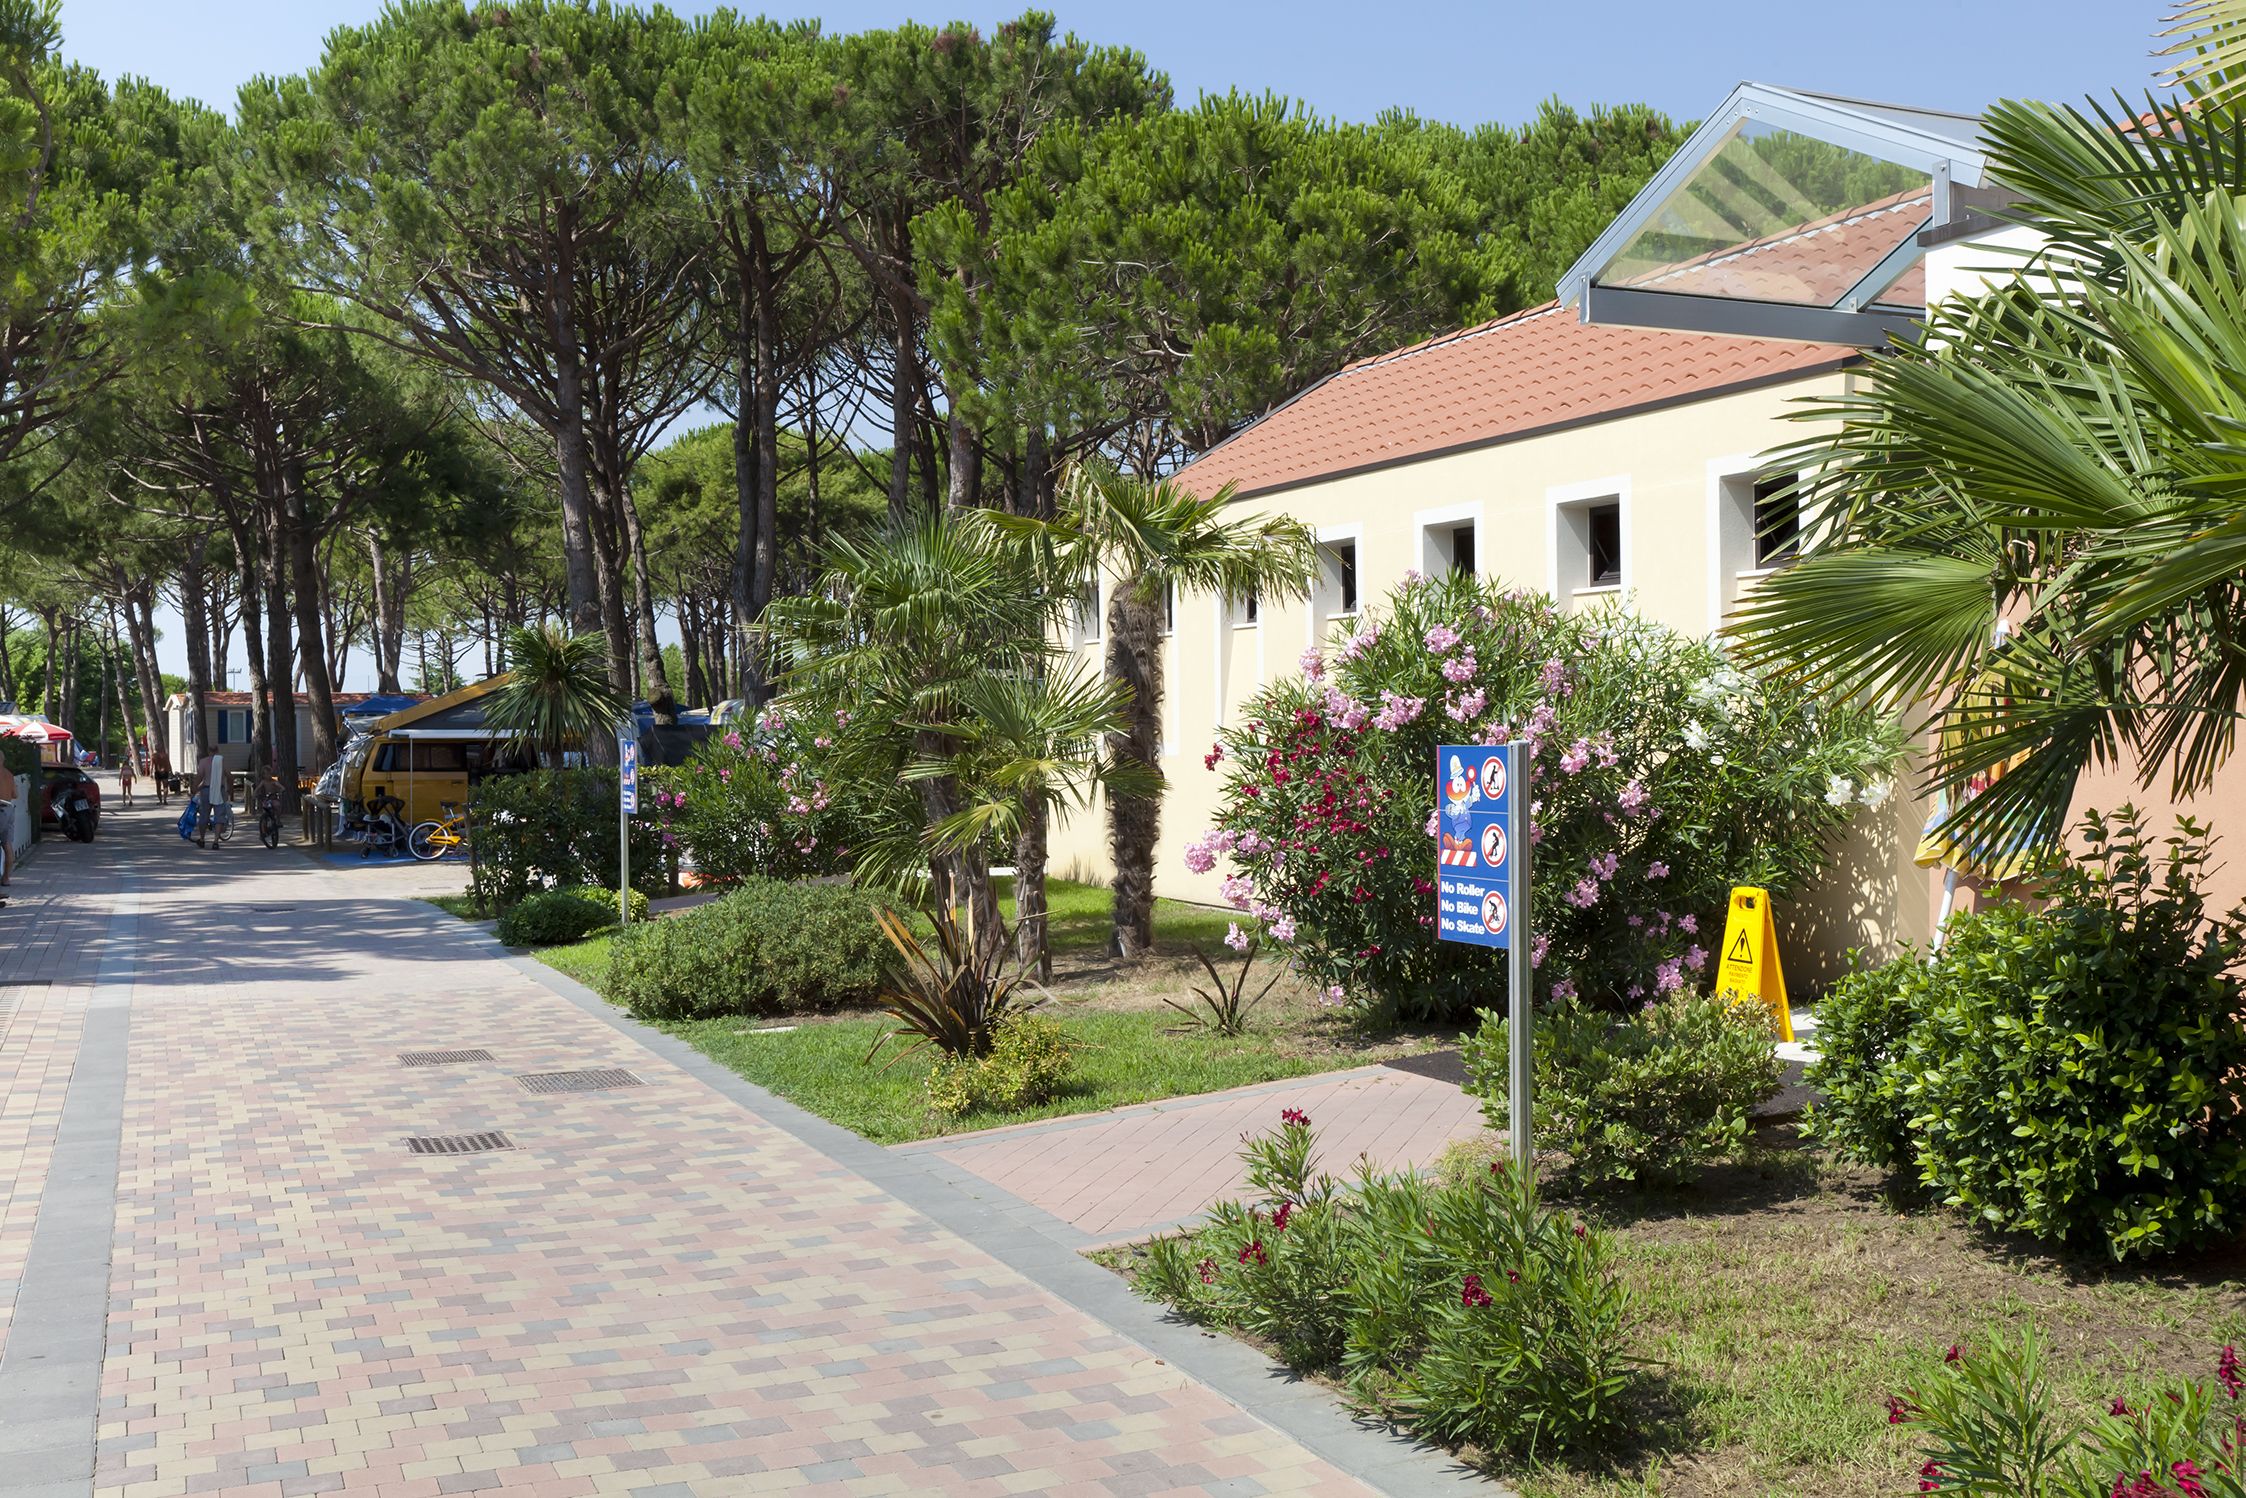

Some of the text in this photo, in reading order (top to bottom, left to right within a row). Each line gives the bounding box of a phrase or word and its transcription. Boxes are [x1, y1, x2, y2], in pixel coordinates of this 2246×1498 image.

[1441, 881, 1485, 896] No Roller
[1441, 898, 1478, 915] No Bike
[1441, 918, 1485, 934] No Skate
[1726, 964, 1752, 973] ATTENZIONE
